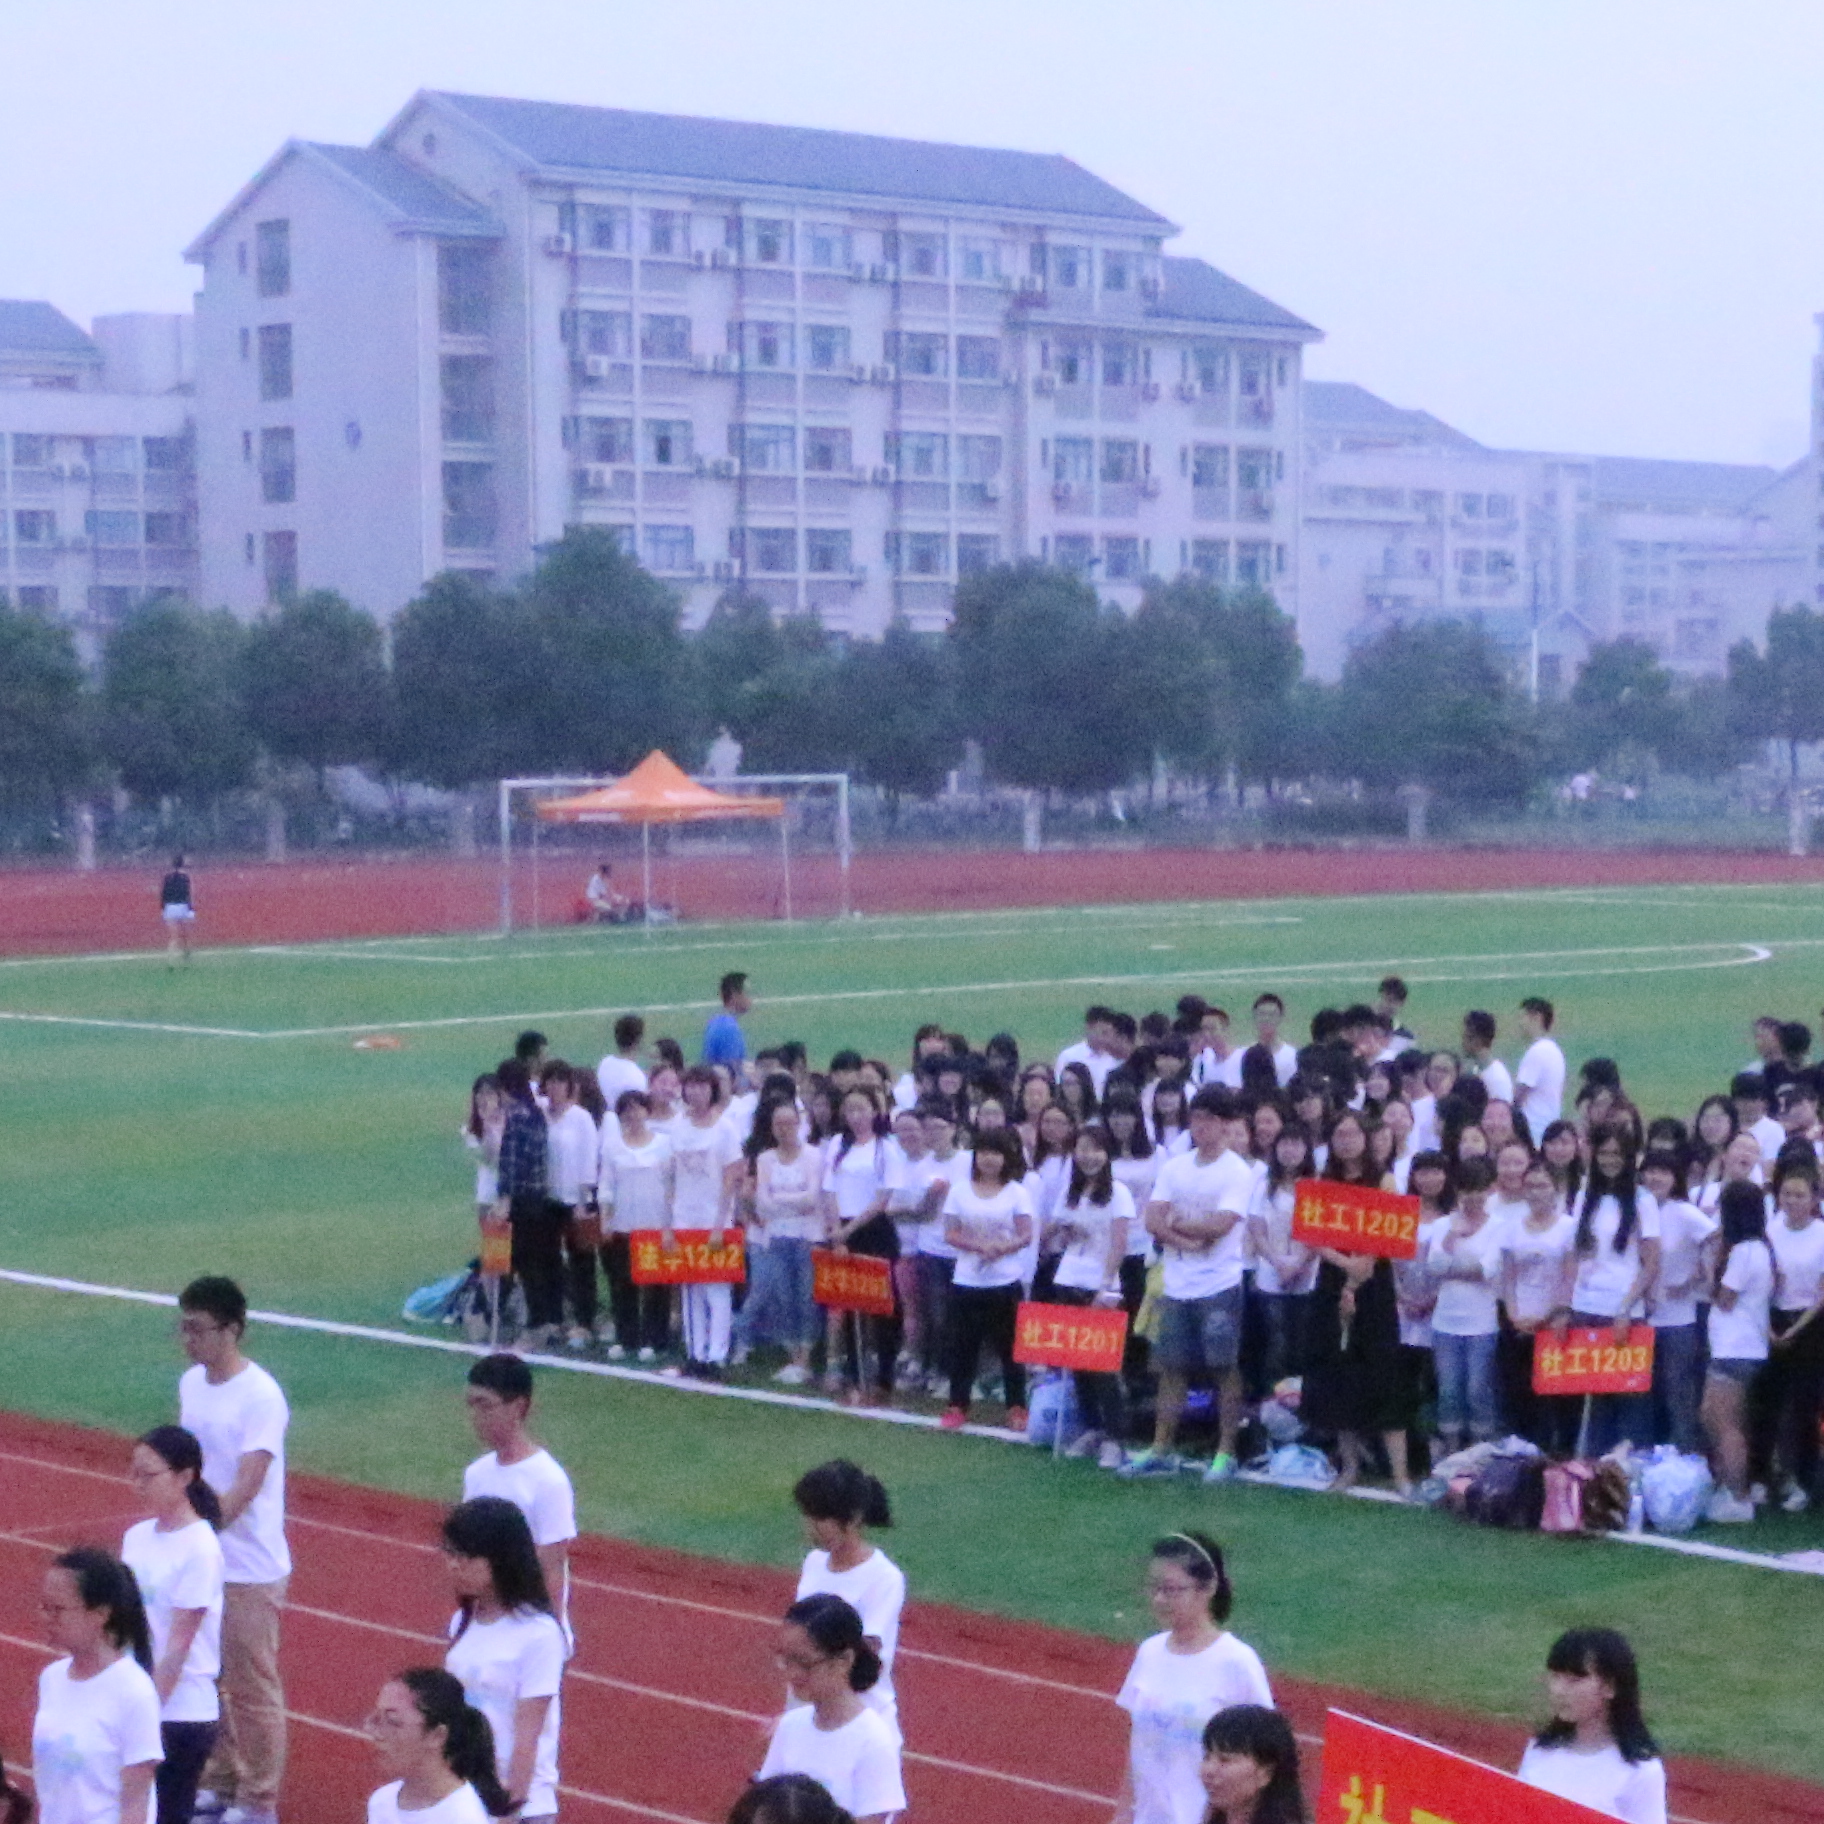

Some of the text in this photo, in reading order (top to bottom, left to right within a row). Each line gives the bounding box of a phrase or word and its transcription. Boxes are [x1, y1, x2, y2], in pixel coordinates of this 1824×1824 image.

[1301, 1197, 1415, 1240] 社工1202
[1022, 1319, 1121, 1354] 社工1201
[1541, 1346, 1648, 1377] 社工1203
